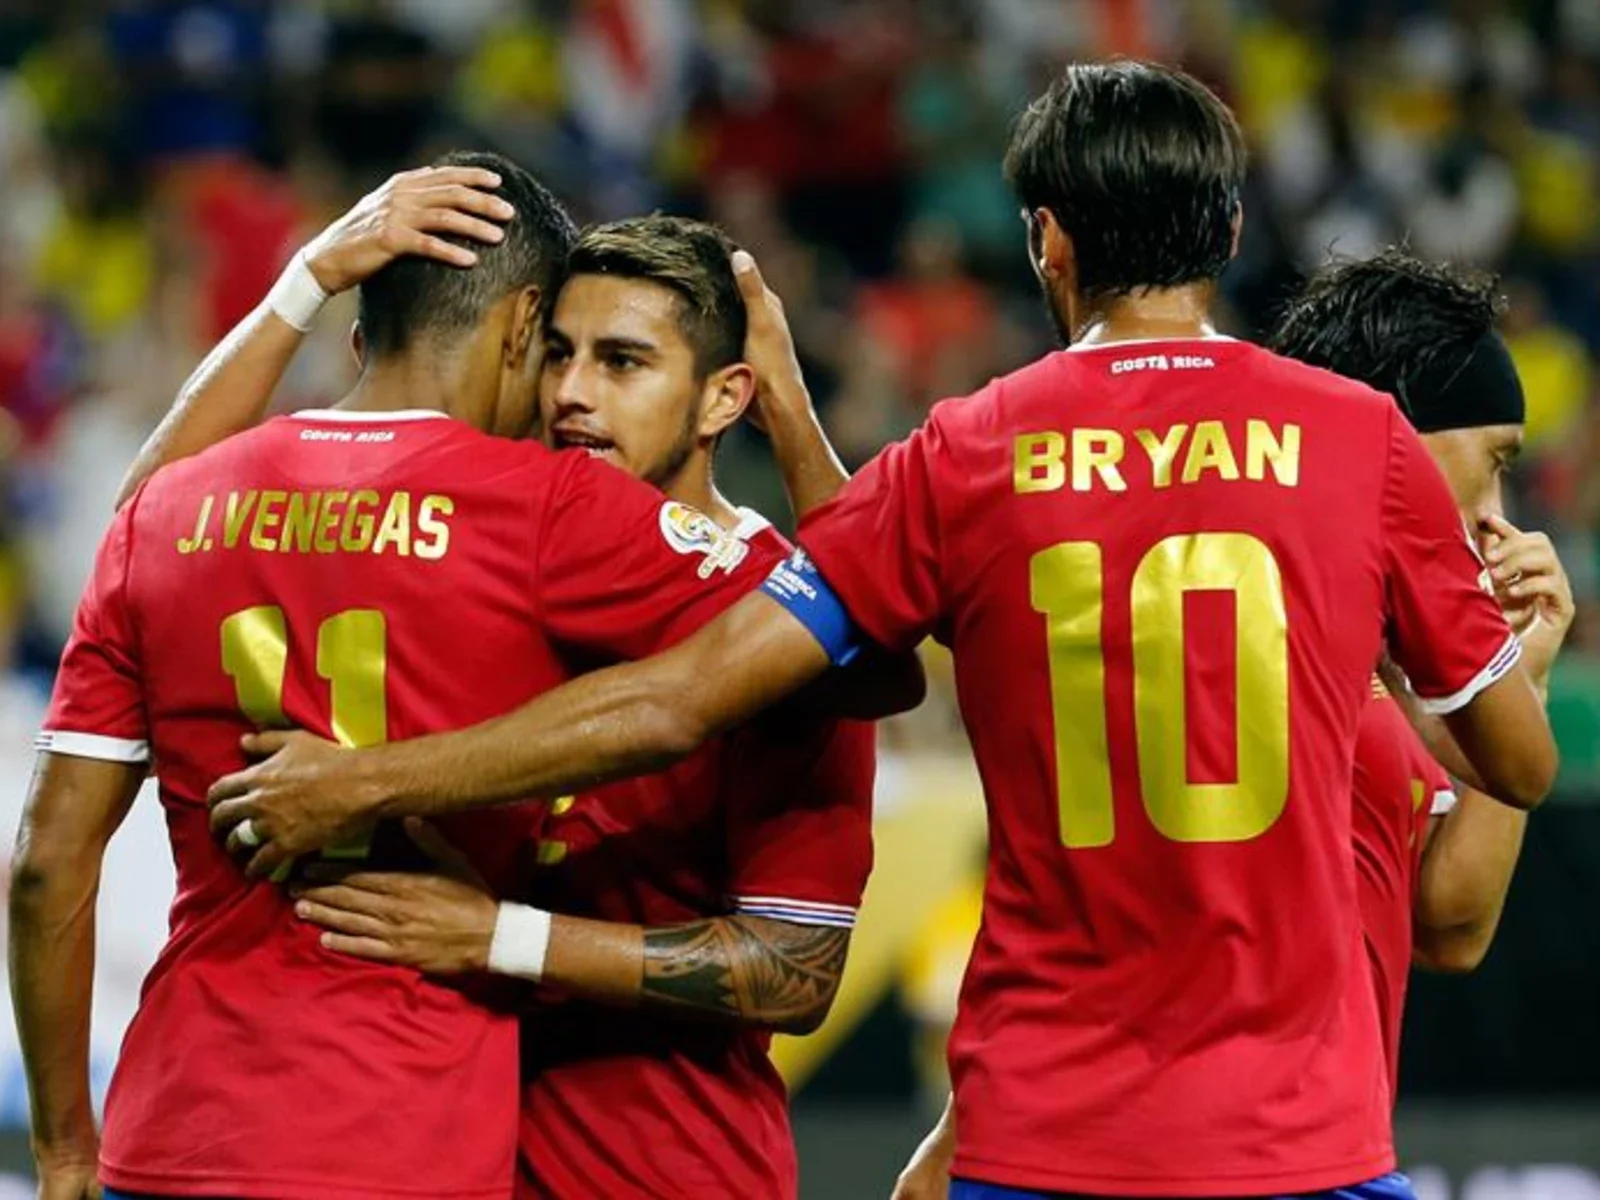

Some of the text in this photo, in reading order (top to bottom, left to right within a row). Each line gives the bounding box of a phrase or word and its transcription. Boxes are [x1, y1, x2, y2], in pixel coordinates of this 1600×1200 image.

[1111, 355, 1216, 374] COSTA RICA
[1014, 419, 1300, 494] BRYAN
[1030, 532, 1289, 849] 10
